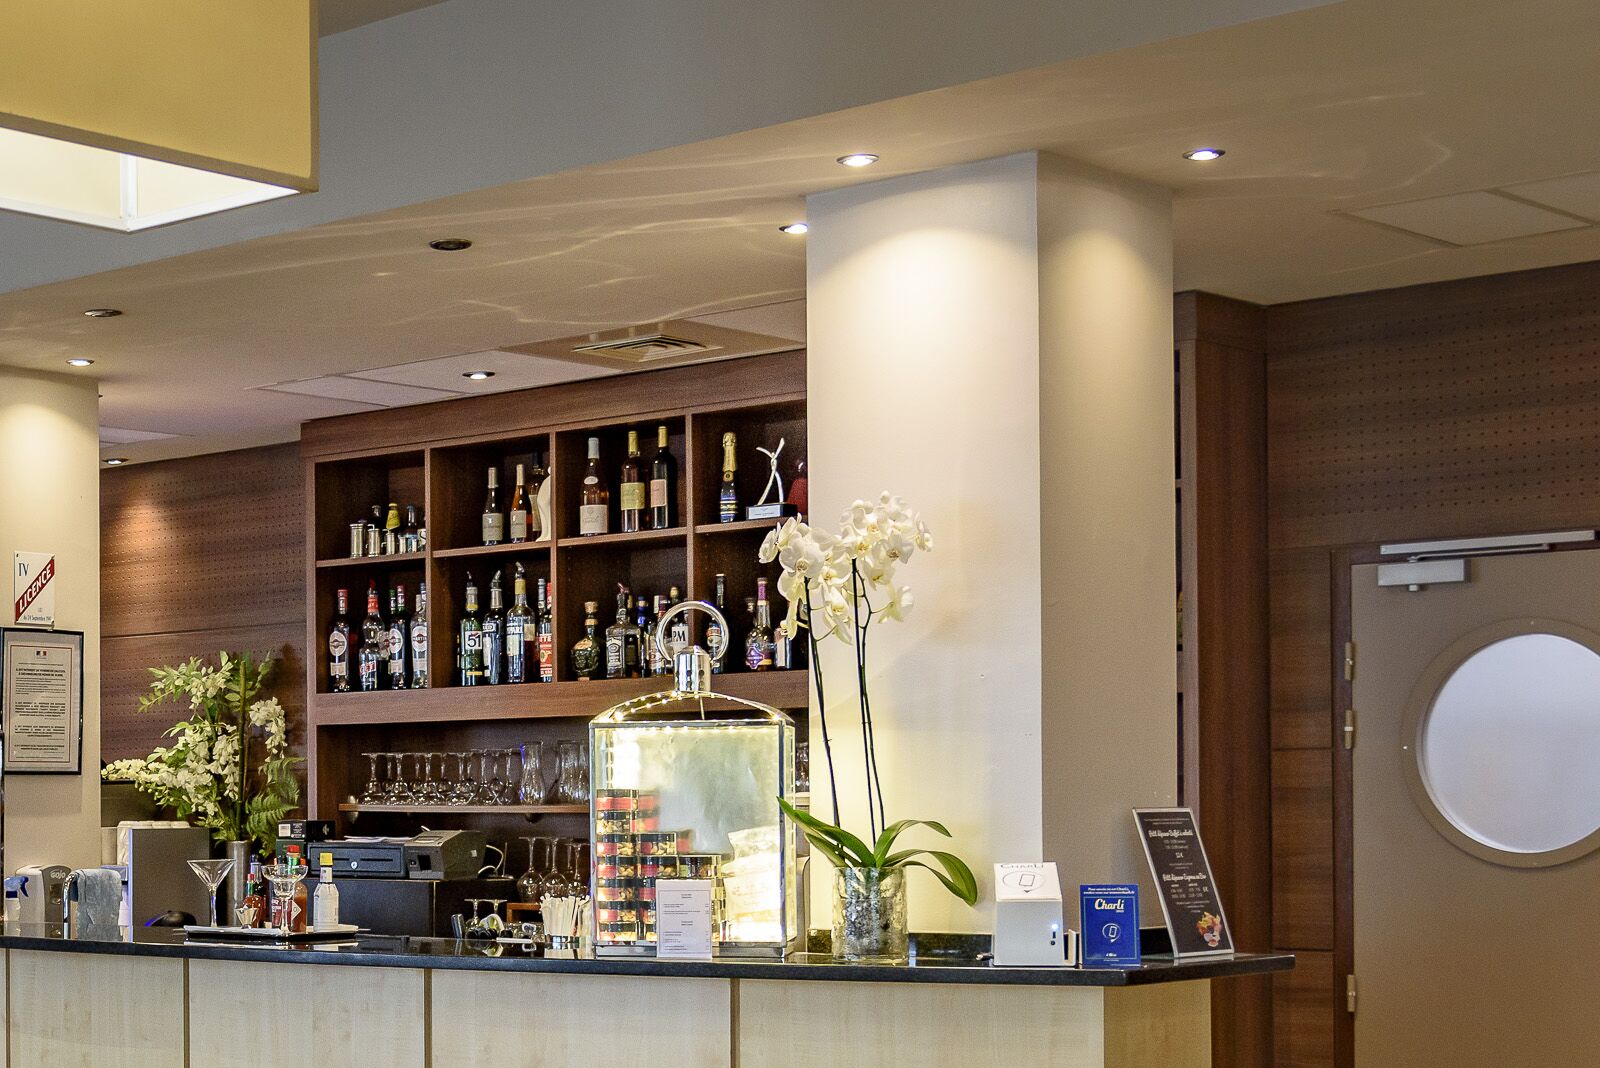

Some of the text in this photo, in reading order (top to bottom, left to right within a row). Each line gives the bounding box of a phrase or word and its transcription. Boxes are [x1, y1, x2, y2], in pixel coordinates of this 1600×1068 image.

[18, 563, 30, 577] IV
[19, 563, 52, 613] LICENCE
[467, 634, 482, 648] 51
[672, 630, 686, 642] PM
[50, 869, 67, 880] GOJO
[1095, 898, 1125, 910] Charli
